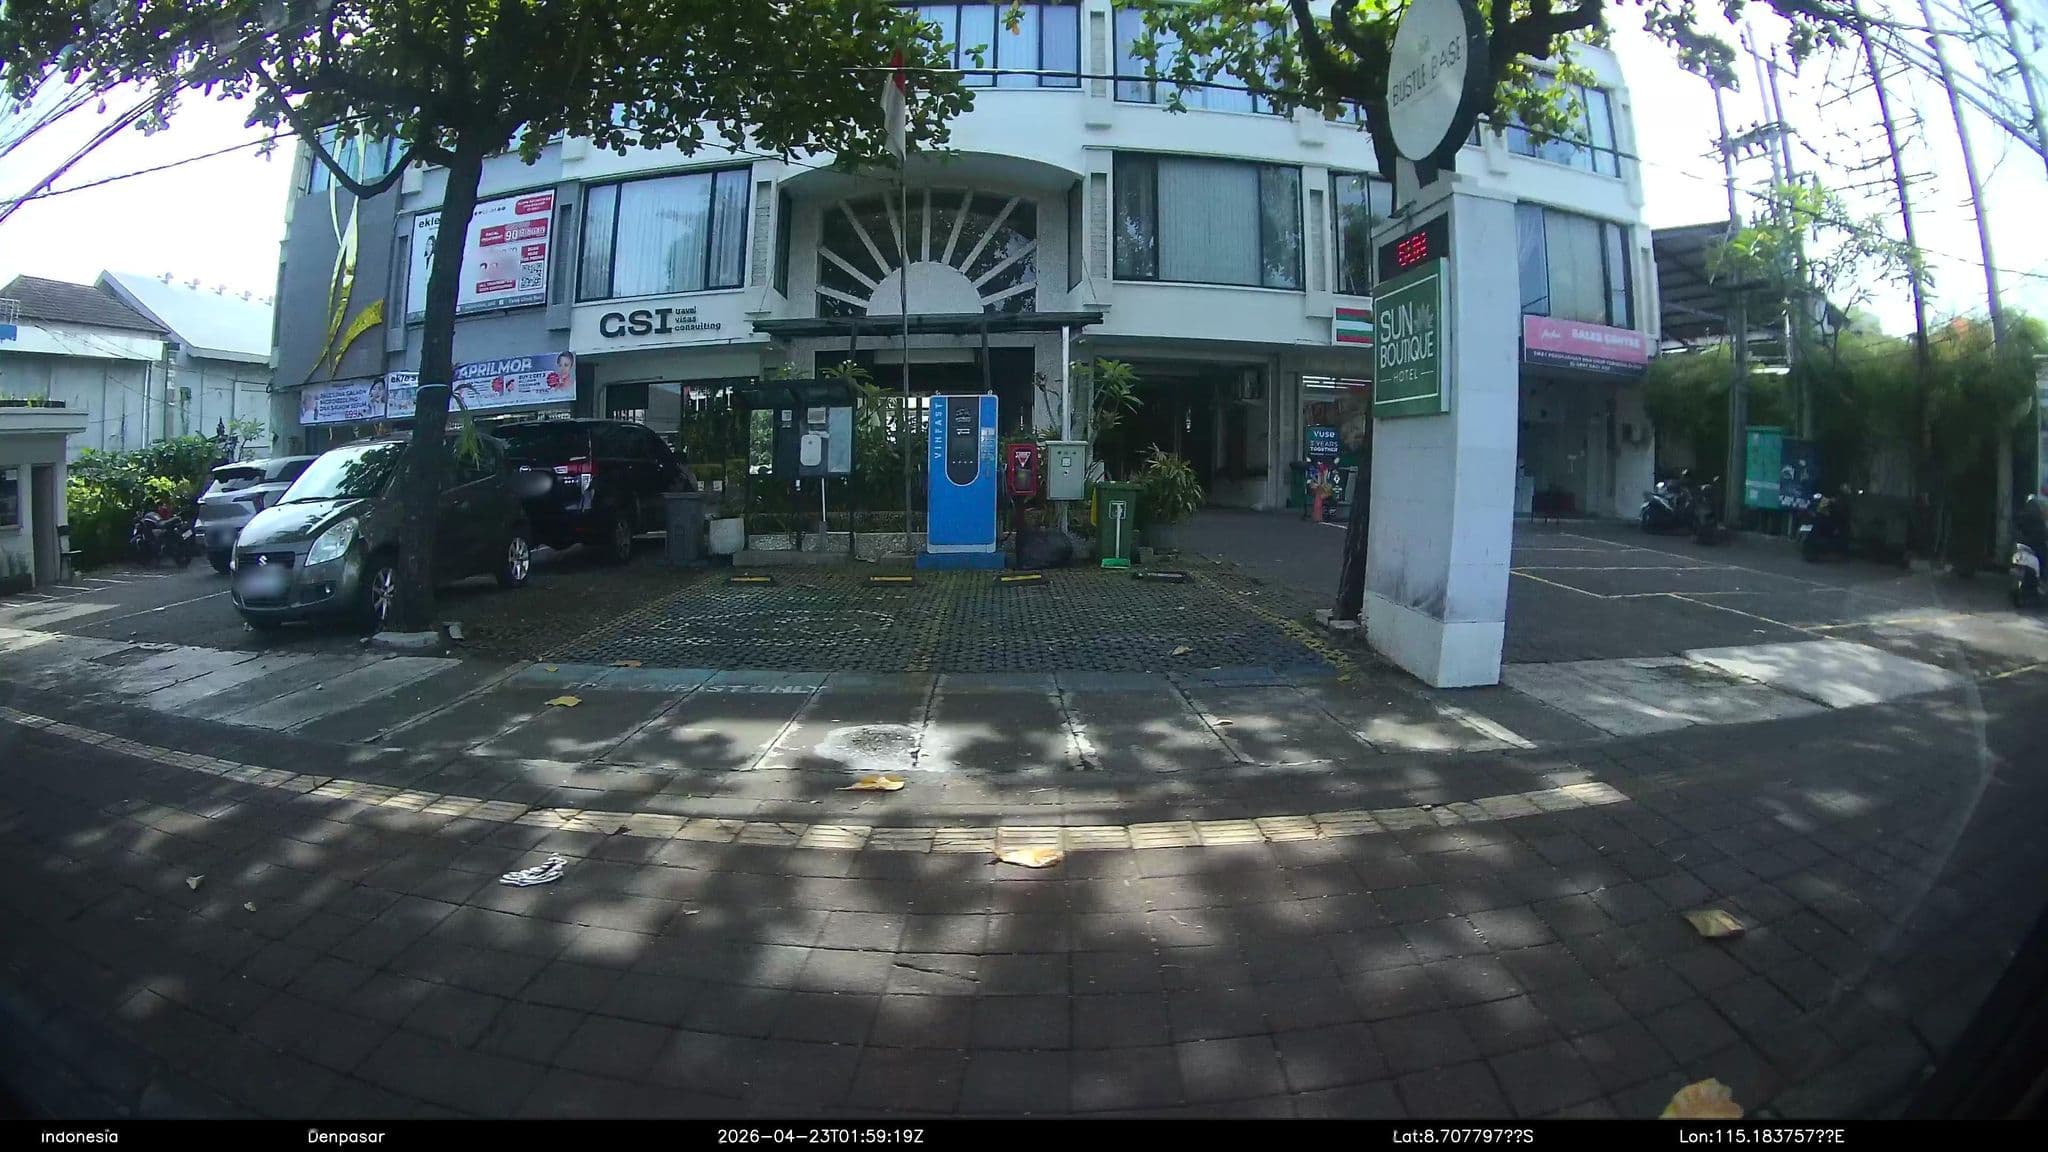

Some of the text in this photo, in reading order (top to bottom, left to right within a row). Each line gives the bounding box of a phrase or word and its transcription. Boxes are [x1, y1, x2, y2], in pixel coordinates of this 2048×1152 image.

[1392, 36, 1461, 107] BUSTLE BASE
[674, 322, 721, 333] consulting
[1380, 301, 1413, 343] SUN
[1380, 331, 1434, 369] BOUTIQUE
[1393, 369, 1418, 383] HOTEL
[934, 403, 944, 459] VINFAST
